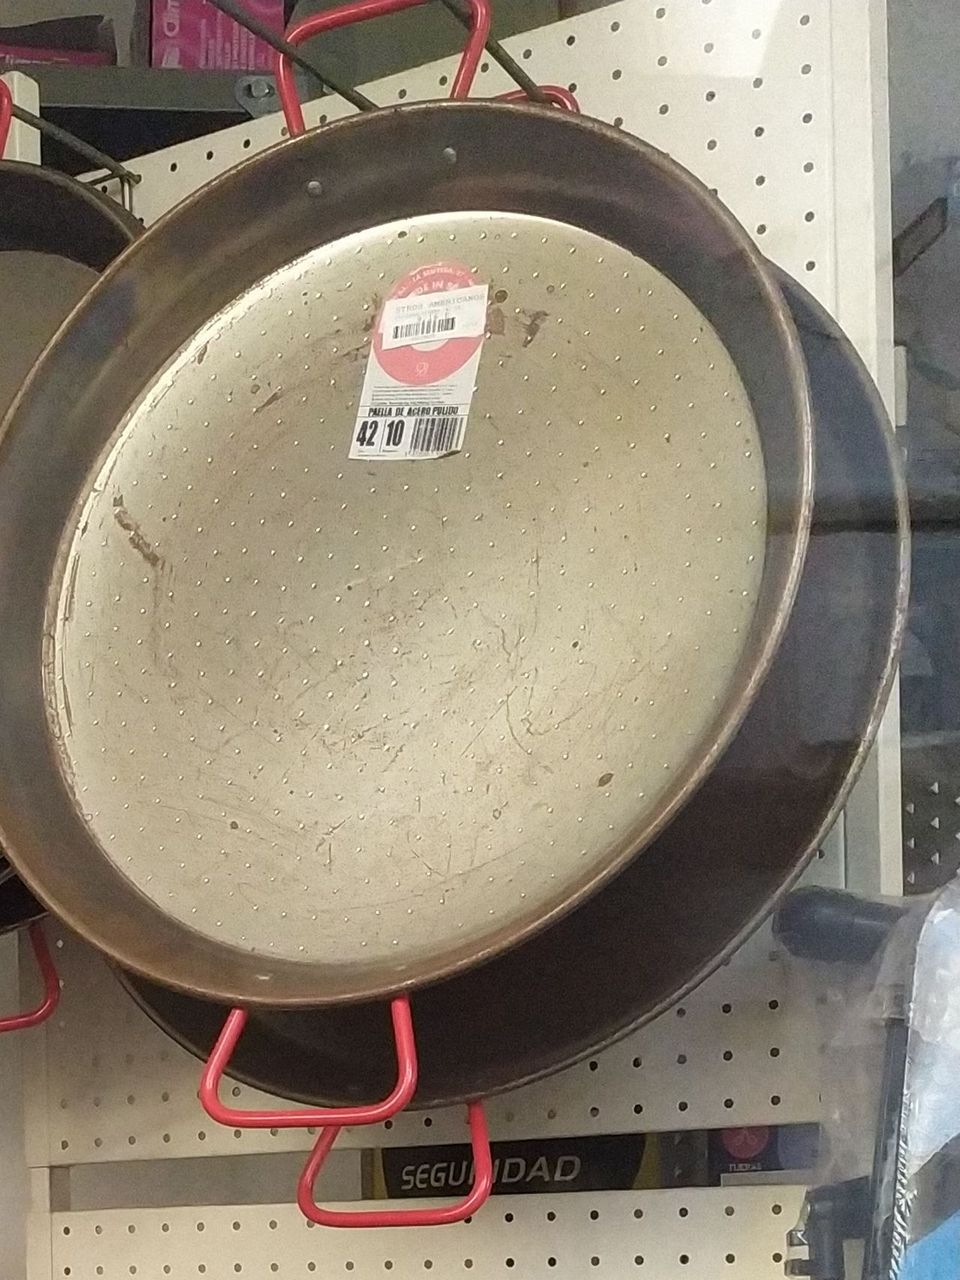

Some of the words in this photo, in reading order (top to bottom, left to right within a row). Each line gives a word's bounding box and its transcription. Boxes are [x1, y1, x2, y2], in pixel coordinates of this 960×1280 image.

[368, 407, 392, 417] PAELLA
[395, 407, 405, 417] DE
[407, 406, 431, 416] ACERO
[432, 406, 459, 415] PULIDO
[356, 420, 379, 447] 42
[386, 419, 405, 446] 10
[401, 1155, 581, 1190] SEGUIDAD
